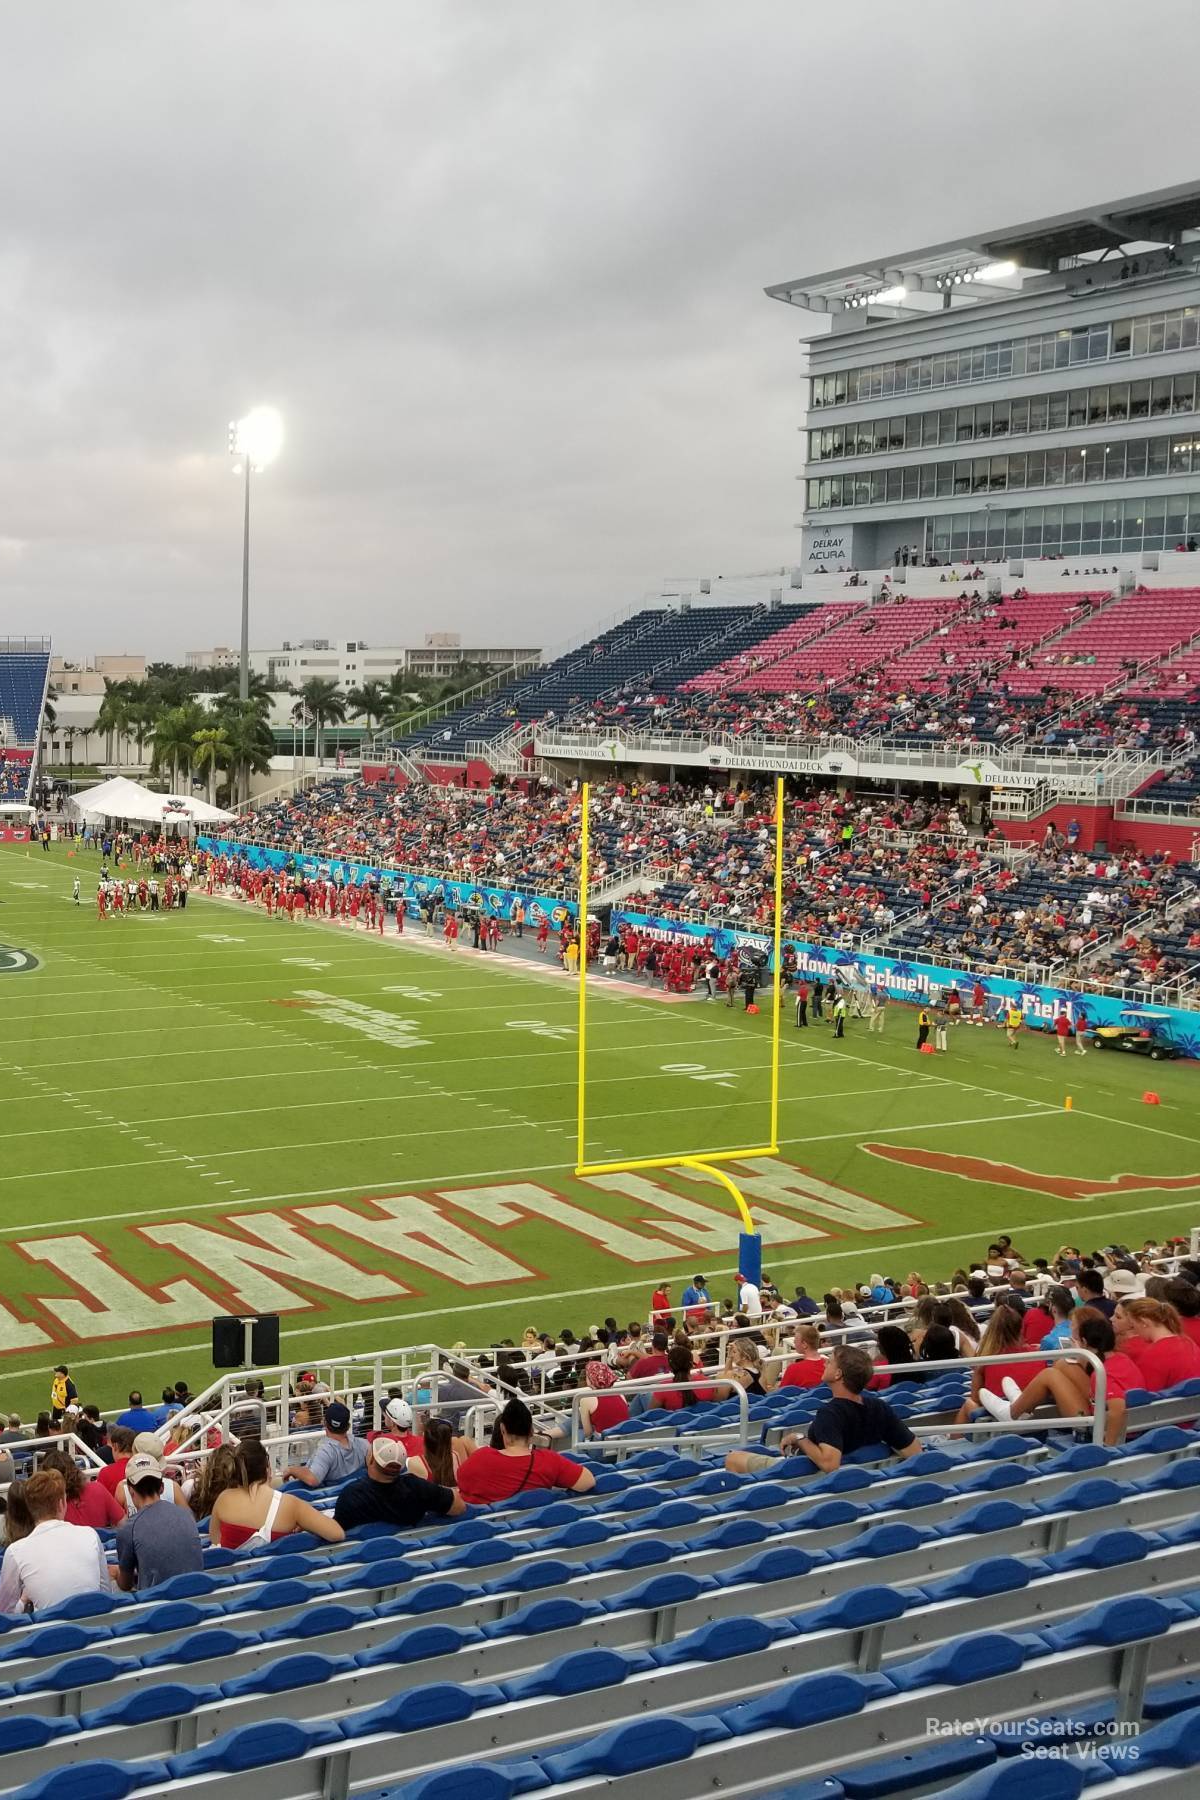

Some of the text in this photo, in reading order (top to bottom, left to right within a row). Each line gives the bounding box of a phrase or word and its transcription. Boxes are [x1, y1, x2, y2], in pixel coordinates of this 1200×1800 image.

[812, 538, 844, 549] DELRAY
[808, 550, 846, 560] ACURA
[590, 750, 606, 758] DECK
[725, 757, 757, 768] DELRAY
[758, 759, 798, 770] HYUNDAI
[800, 762, 824, 772] DECK
[985, 774, 1022, 784] DELRAY
[737, 936, 771, 952] FAU
[1021, 993, 1073, 1023] Field
[505, 1020, 579, 1038] 20
[659, 1063, 741, 1081] 10
